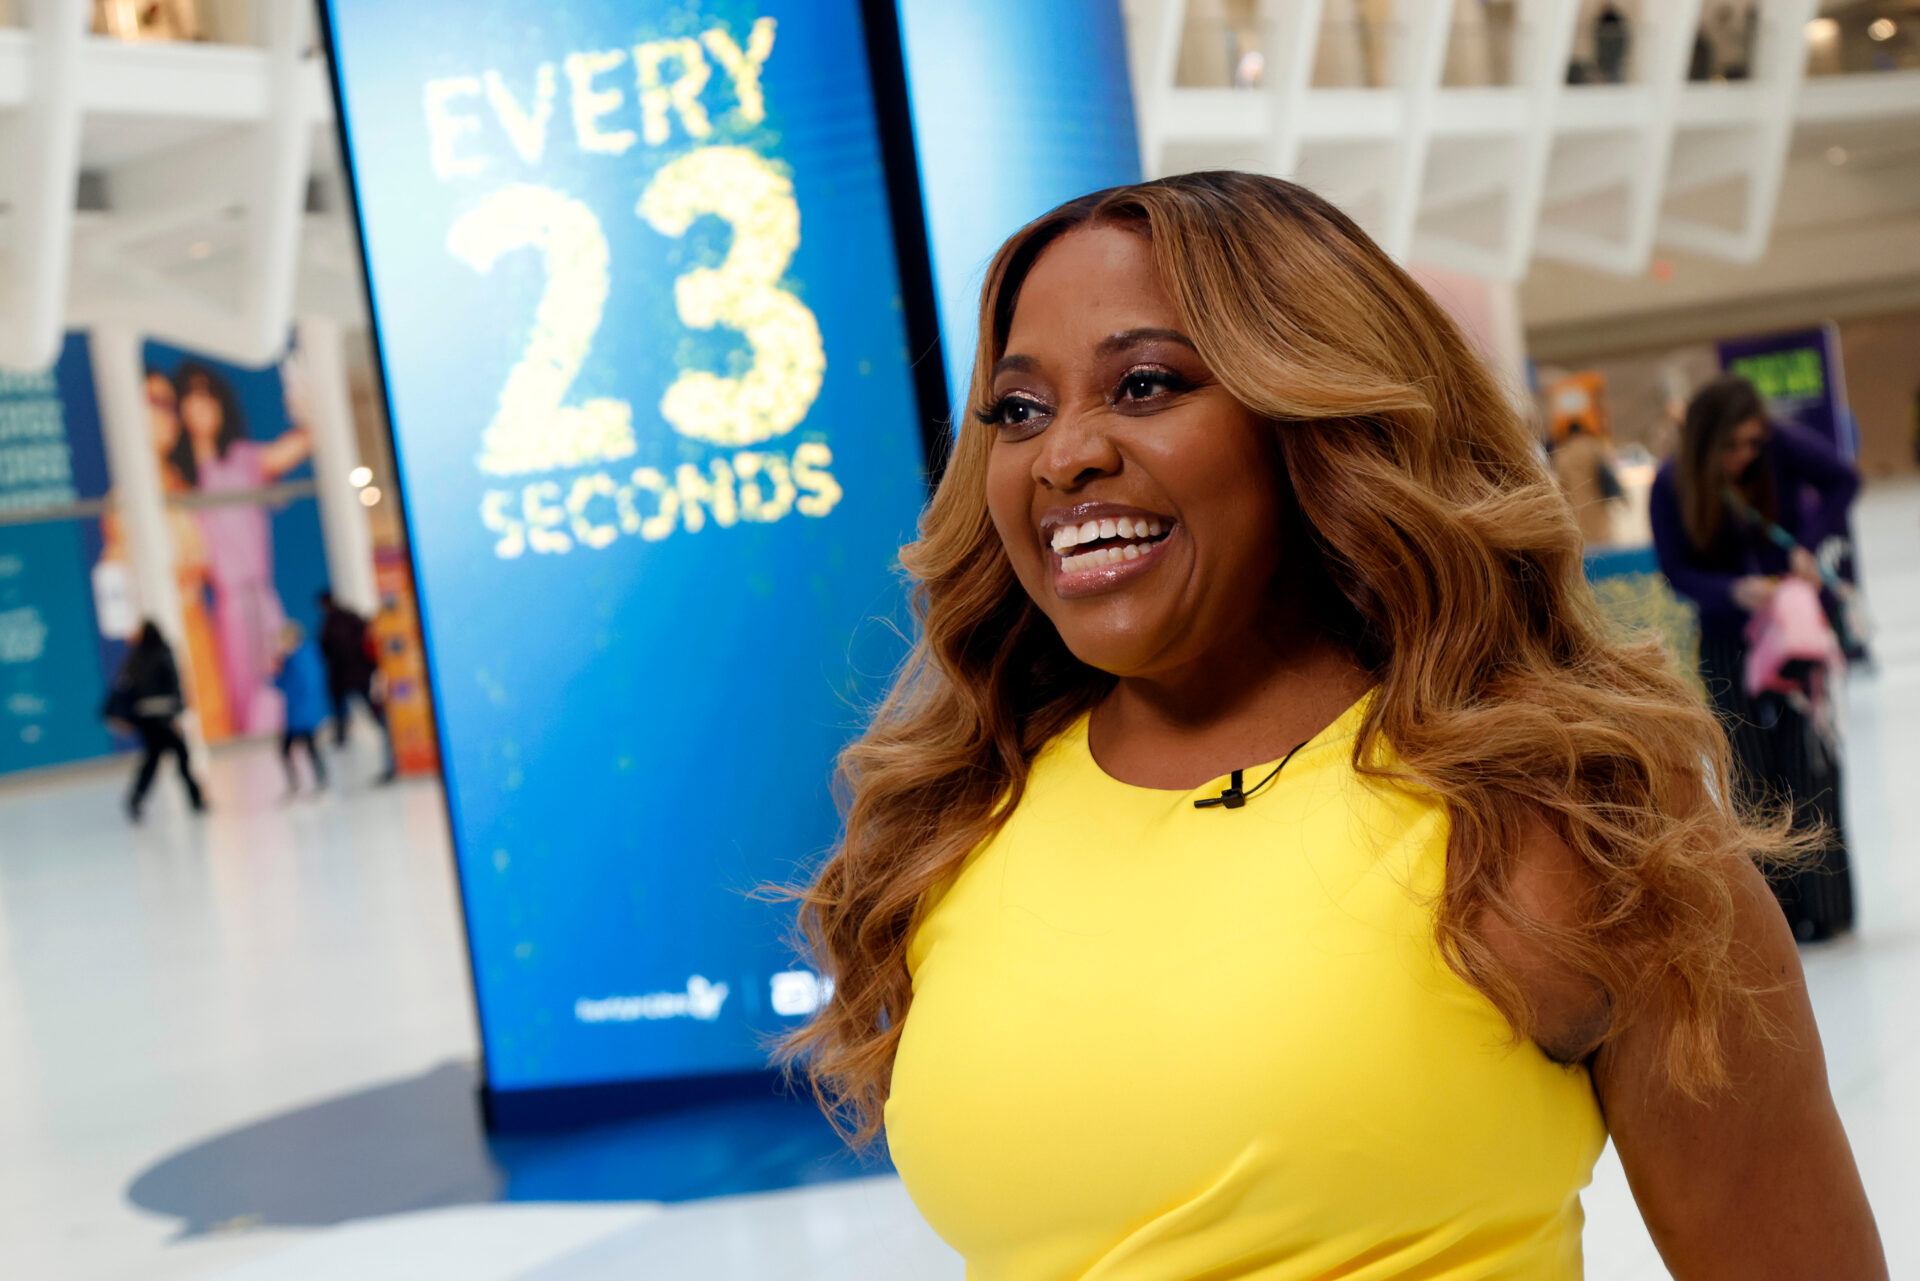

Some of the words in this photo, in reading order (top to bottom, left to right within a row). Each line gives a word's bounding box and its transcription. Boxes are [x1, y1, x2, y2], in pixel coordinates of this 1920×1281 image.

[423, 16, 777, 180] EVERY
[446, 145, 827, 476] 23
[480, 442, 842, 559] SECONDS
